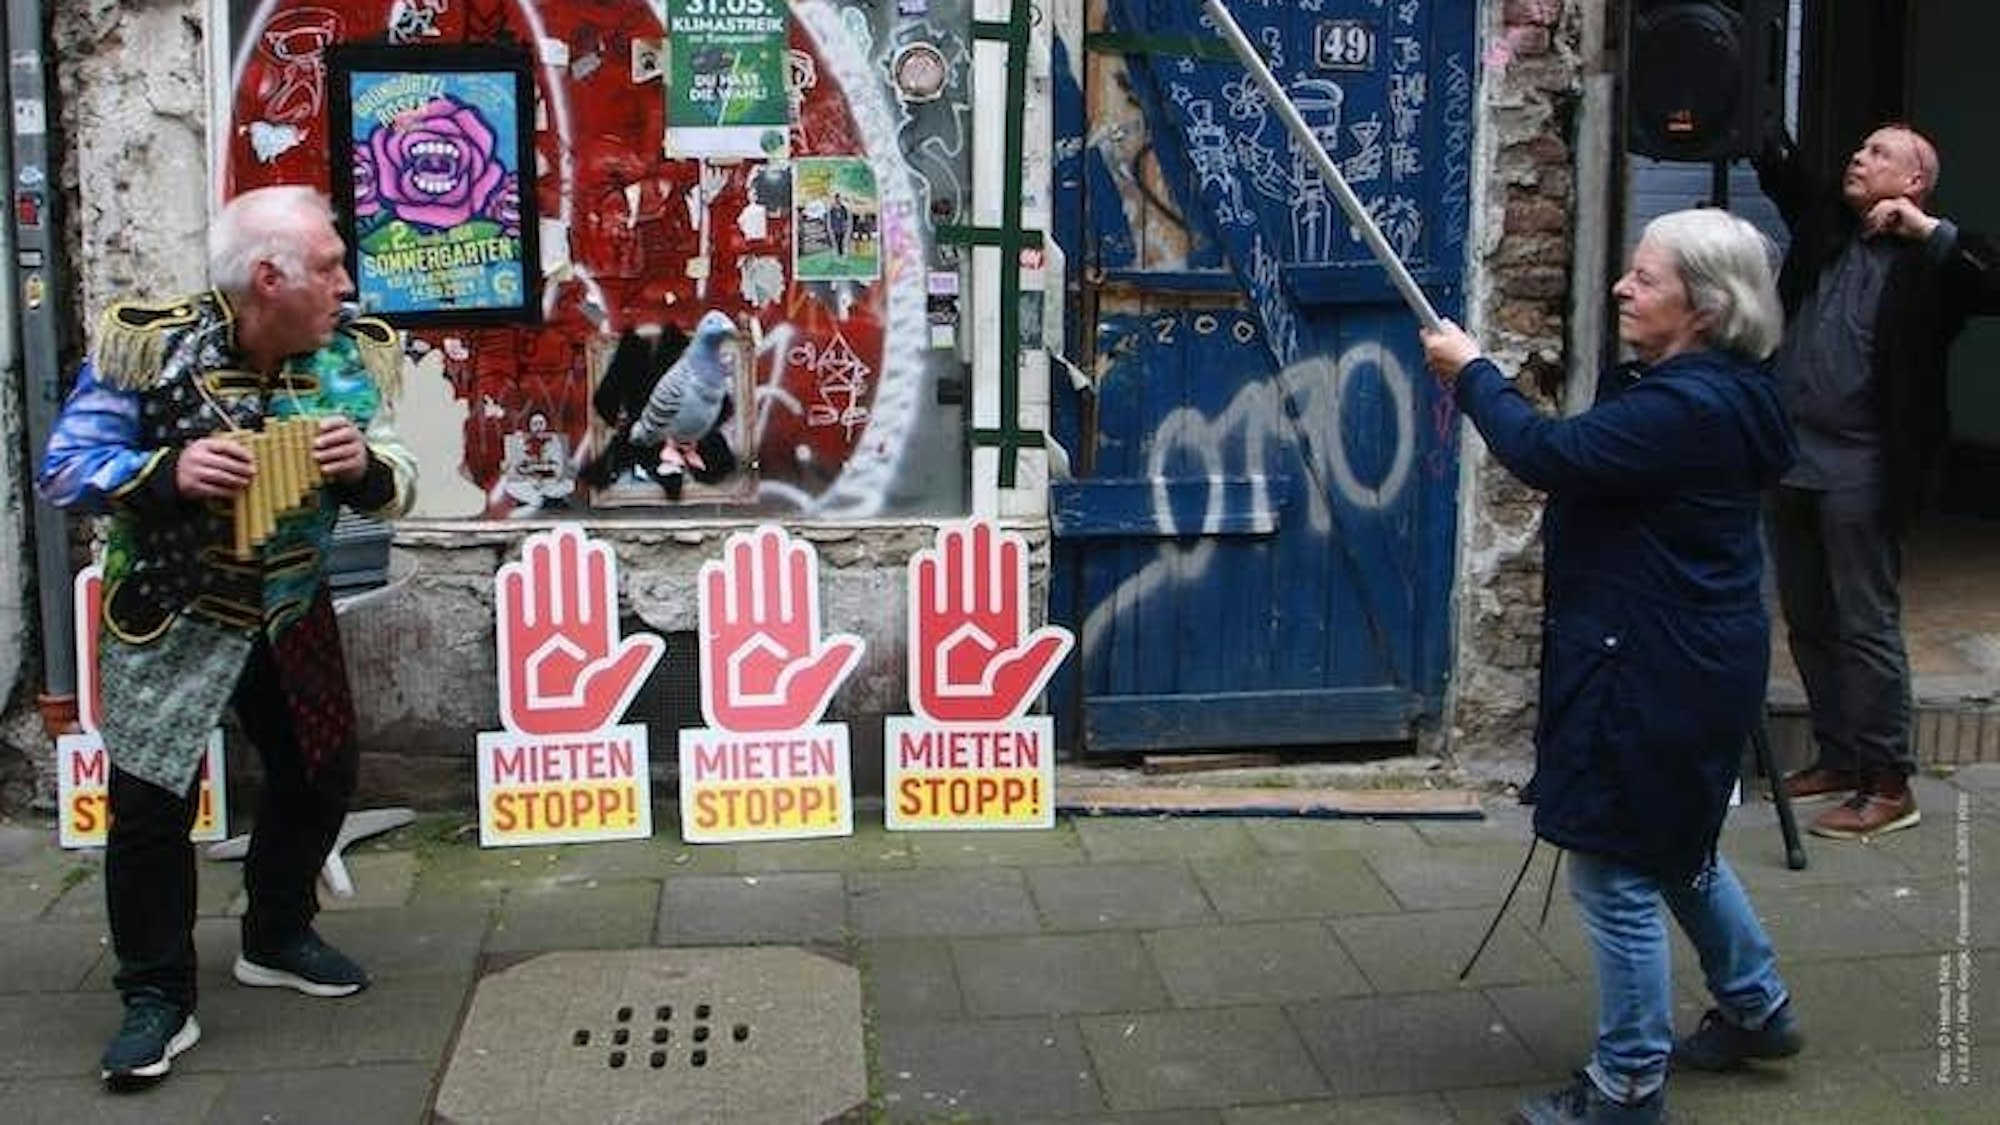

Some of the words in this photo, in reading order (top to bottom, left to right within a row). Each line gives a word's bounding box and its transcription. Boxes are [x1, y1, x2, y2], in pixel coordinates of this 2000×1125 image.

[671, 17, 784, 33] KLIMASTREIK
[1323, 26, 1367, 63] 49
[363, 236, 514, 279] SOMMERGARTEN
[492, 740, 634, 784] MIETEN
[694, 740, 835, 783] MIETEN
[901, 732, 1039, 770] MIETEN
[493, 787, 636, 831] STOPP!
[695, 787, 837, 830] STOPP!
[899, 777, 1039, 816] STOPP!
